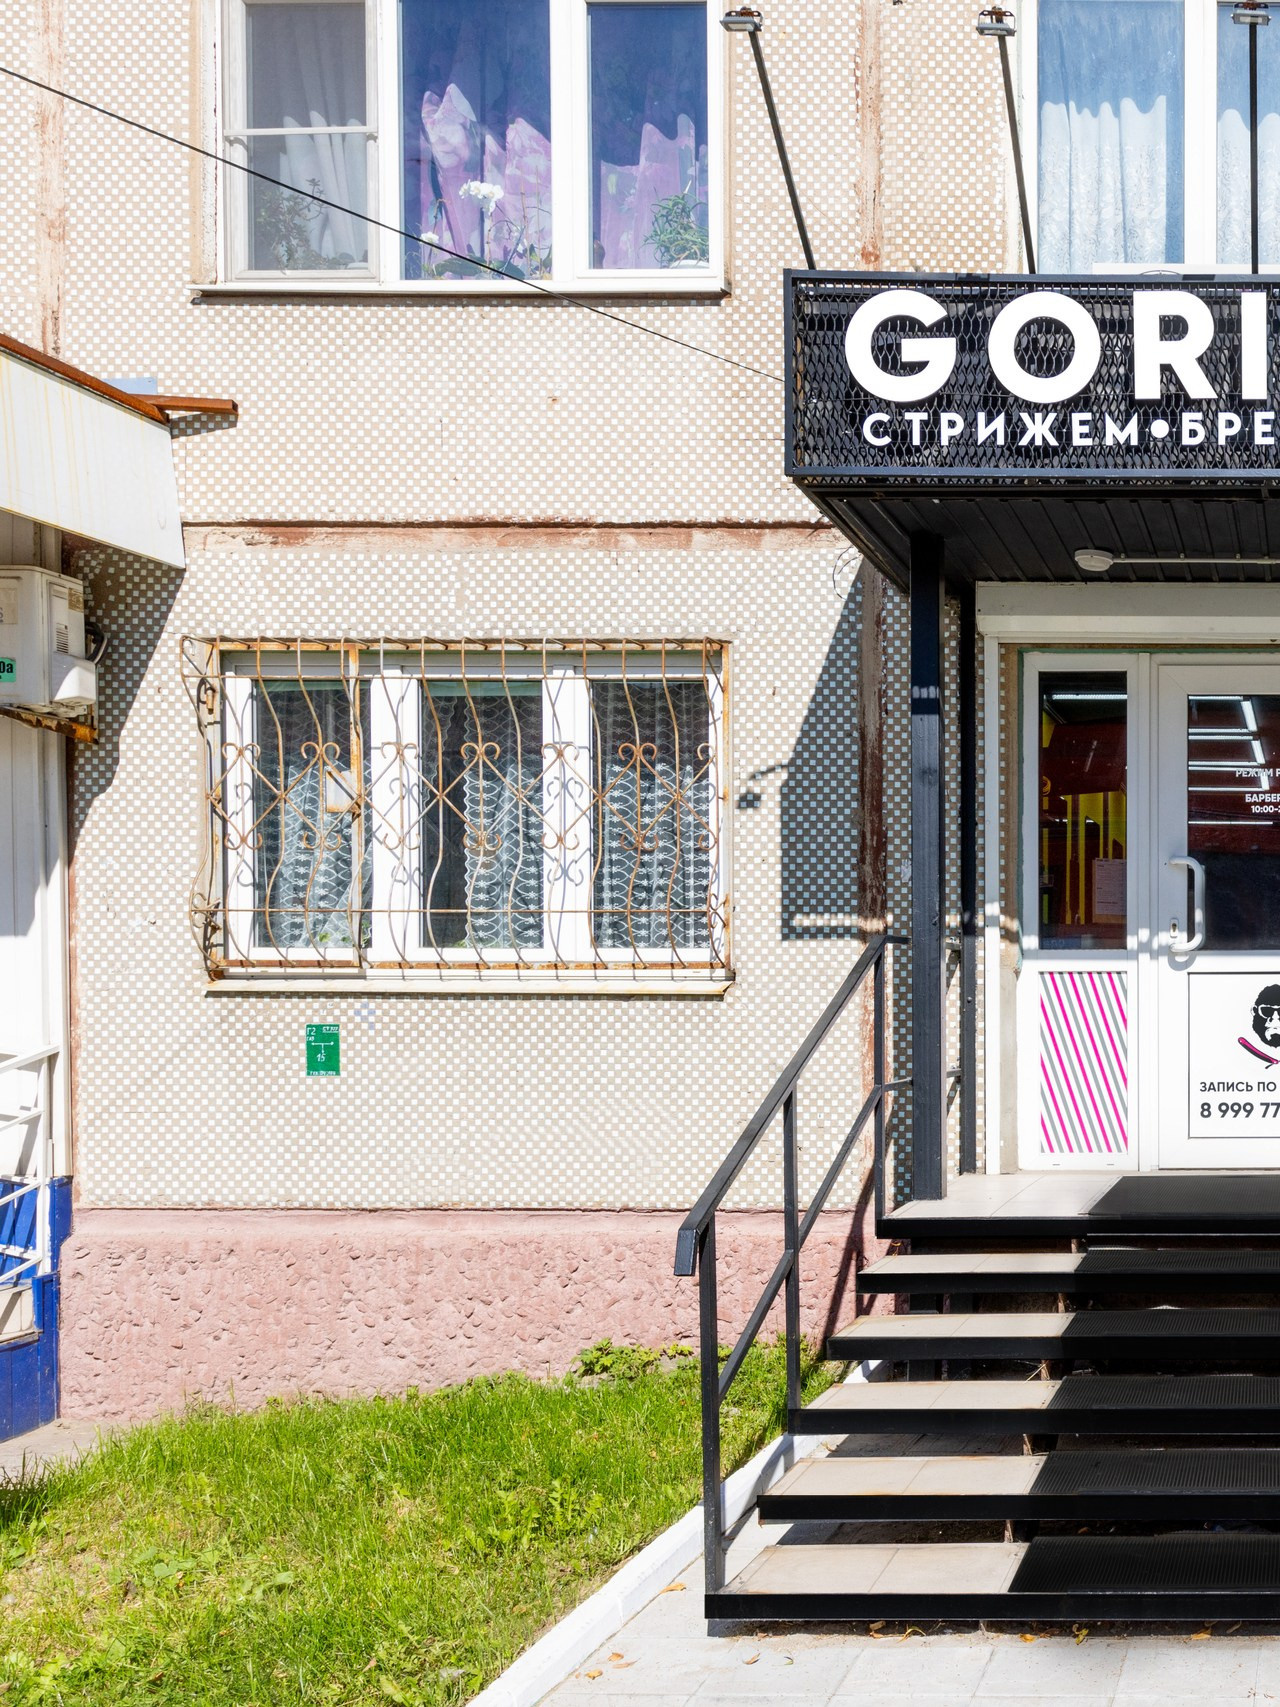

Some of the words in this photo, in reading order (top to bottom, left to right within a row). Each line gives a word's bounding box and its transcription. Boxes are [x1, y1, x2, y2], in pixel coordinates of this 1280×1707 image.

[1235, 768, 1273, 778] РЕЖИМ
[1199, 1081, 1254, 1093] ЗАПИСЬ
[1257, 1081, 1277, 1093] ПО
[1200, 1102, 1212, 1119] 8
[1217, 1102, 1255, 1119] 999
